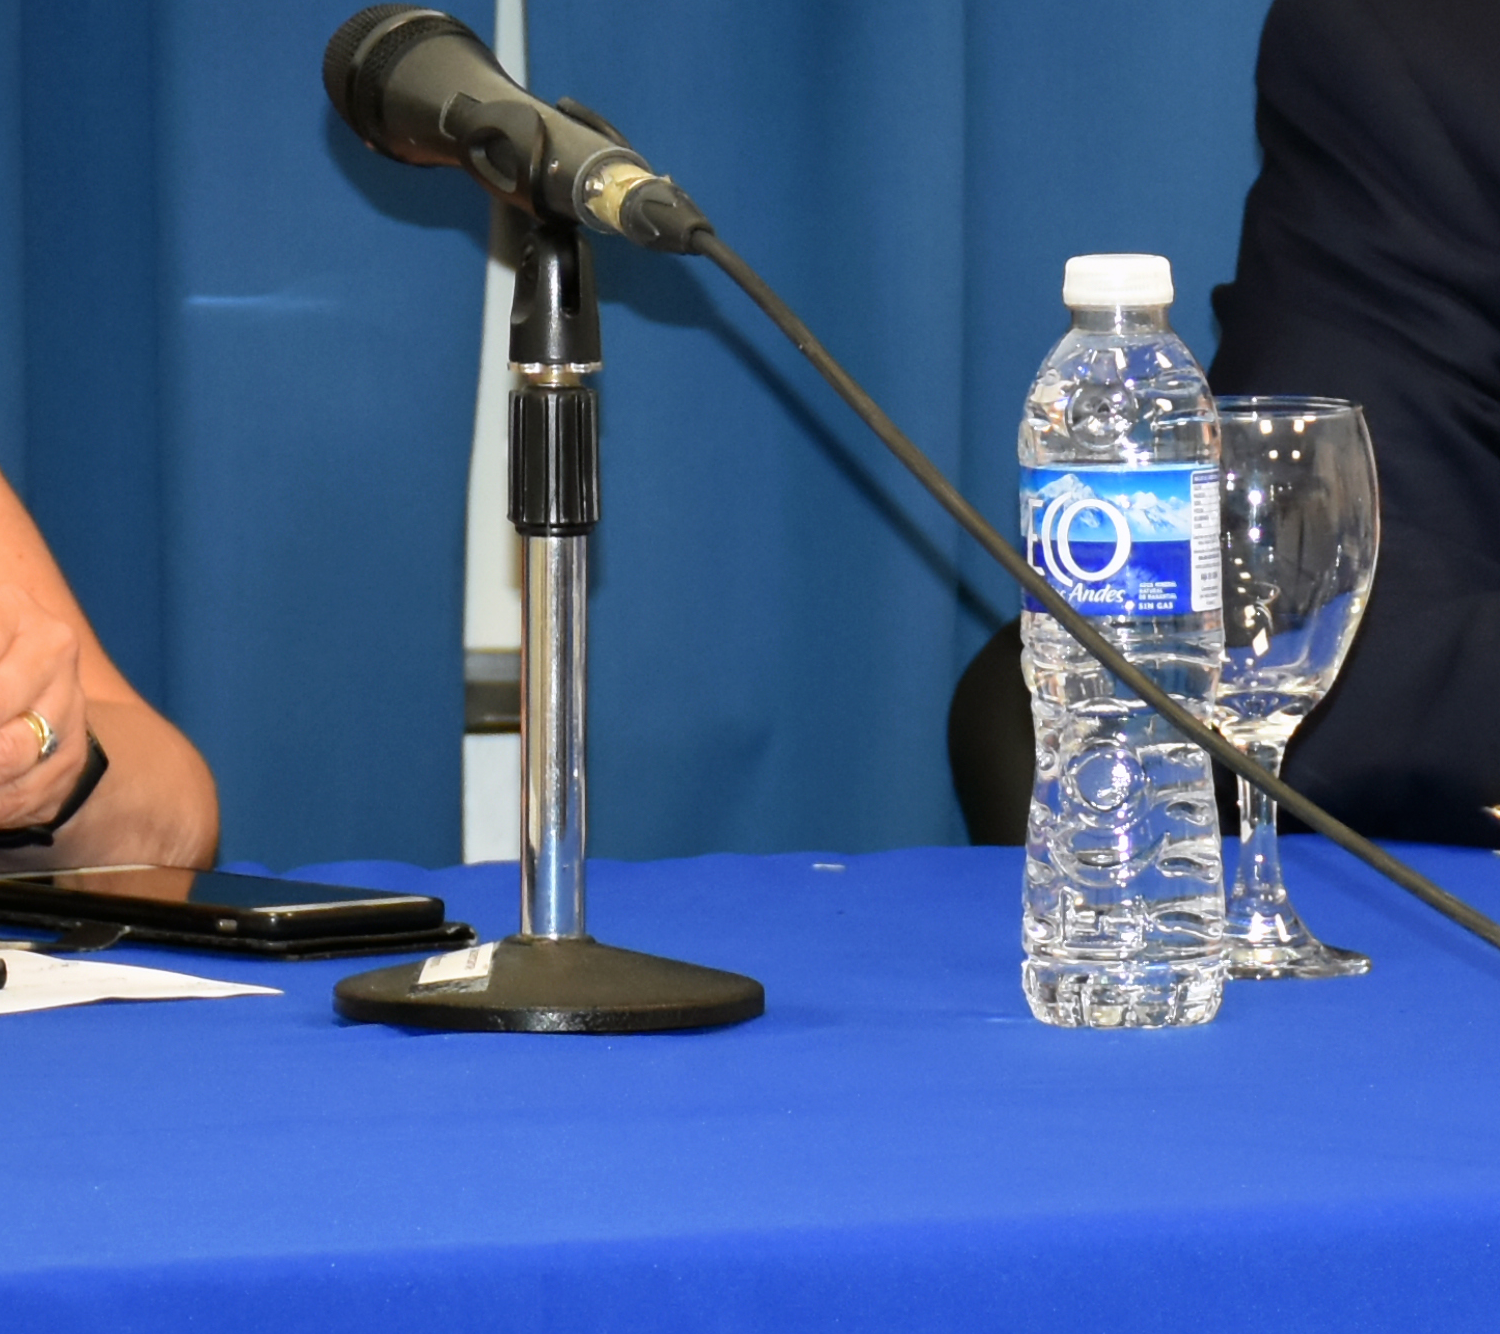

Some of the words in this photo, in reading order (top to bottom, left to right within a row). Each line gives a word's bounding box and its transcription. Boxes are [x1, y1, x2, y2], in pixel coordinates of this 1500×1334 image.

[1027, 491, 1132, 588] ECO
[1069, 582, 1126, 603] Andes
[1138, 602, 1154, 610] SIN
[1156, 601, 1174, 610] GAS
